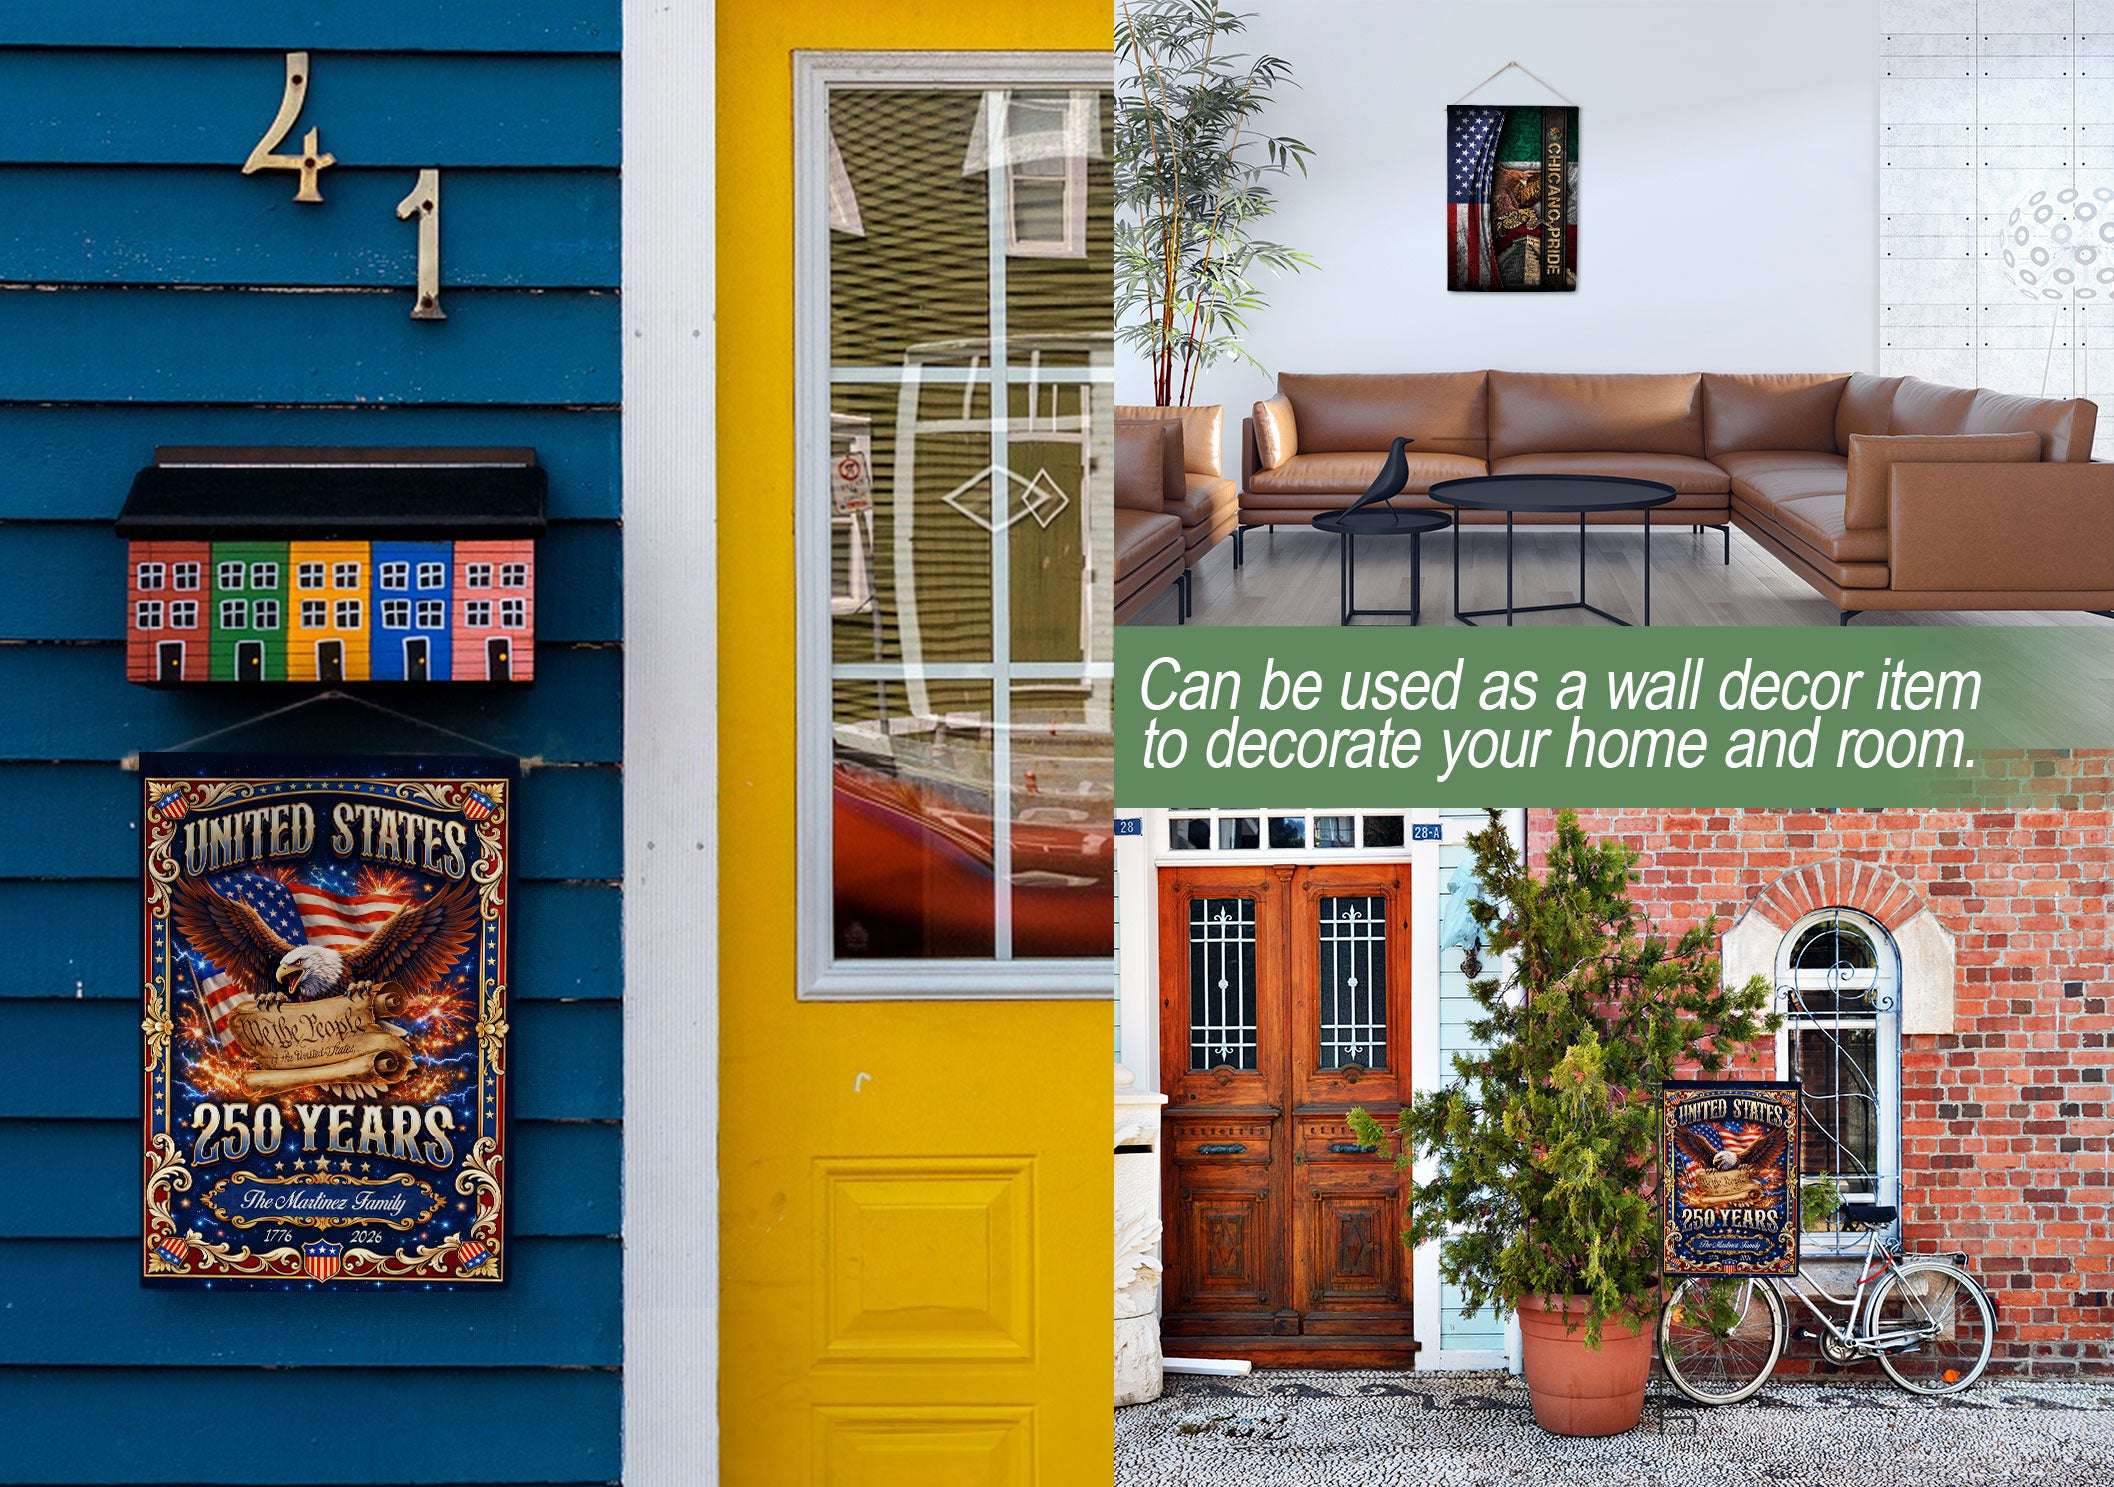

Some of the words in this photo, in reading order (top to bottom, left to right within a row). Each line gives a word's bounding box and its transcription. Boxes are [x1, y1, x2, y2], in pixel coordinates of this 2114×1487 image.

[241, 51, 337, 202] 4
[1547, 144, 1562, 220] CHICANO
[396, 168, 447, 319] 1
[1547, 227, 1561, 275] PRIDE
[184, 802, 315, 876] UNITED
[332, 802, 467, 880] STATES
[1120, 821, 1134, 833] 28
[1414, 826, 1440, 839] 28-A
[299, 1006, 367, 1043] People
[1678, 1098, 1727, 1126] UNITED
[1732, 1098, 1783, 1128] STATES
[191, 1102, 282, 1167] 250
[293, 1104, 456, 1169] YEARS
[240, 1189, 274, 1209] The
[273, 1189, 349, 1211] Martinez
[351, 1189, 408, 1215] Family
[264, 1229, 293, 1243] 1776
[350, 1229, 383, 1244] 2026
[1681, 1209, 1716, 1233] 250
[1719, 1210, 1780, 1233] YEARS
